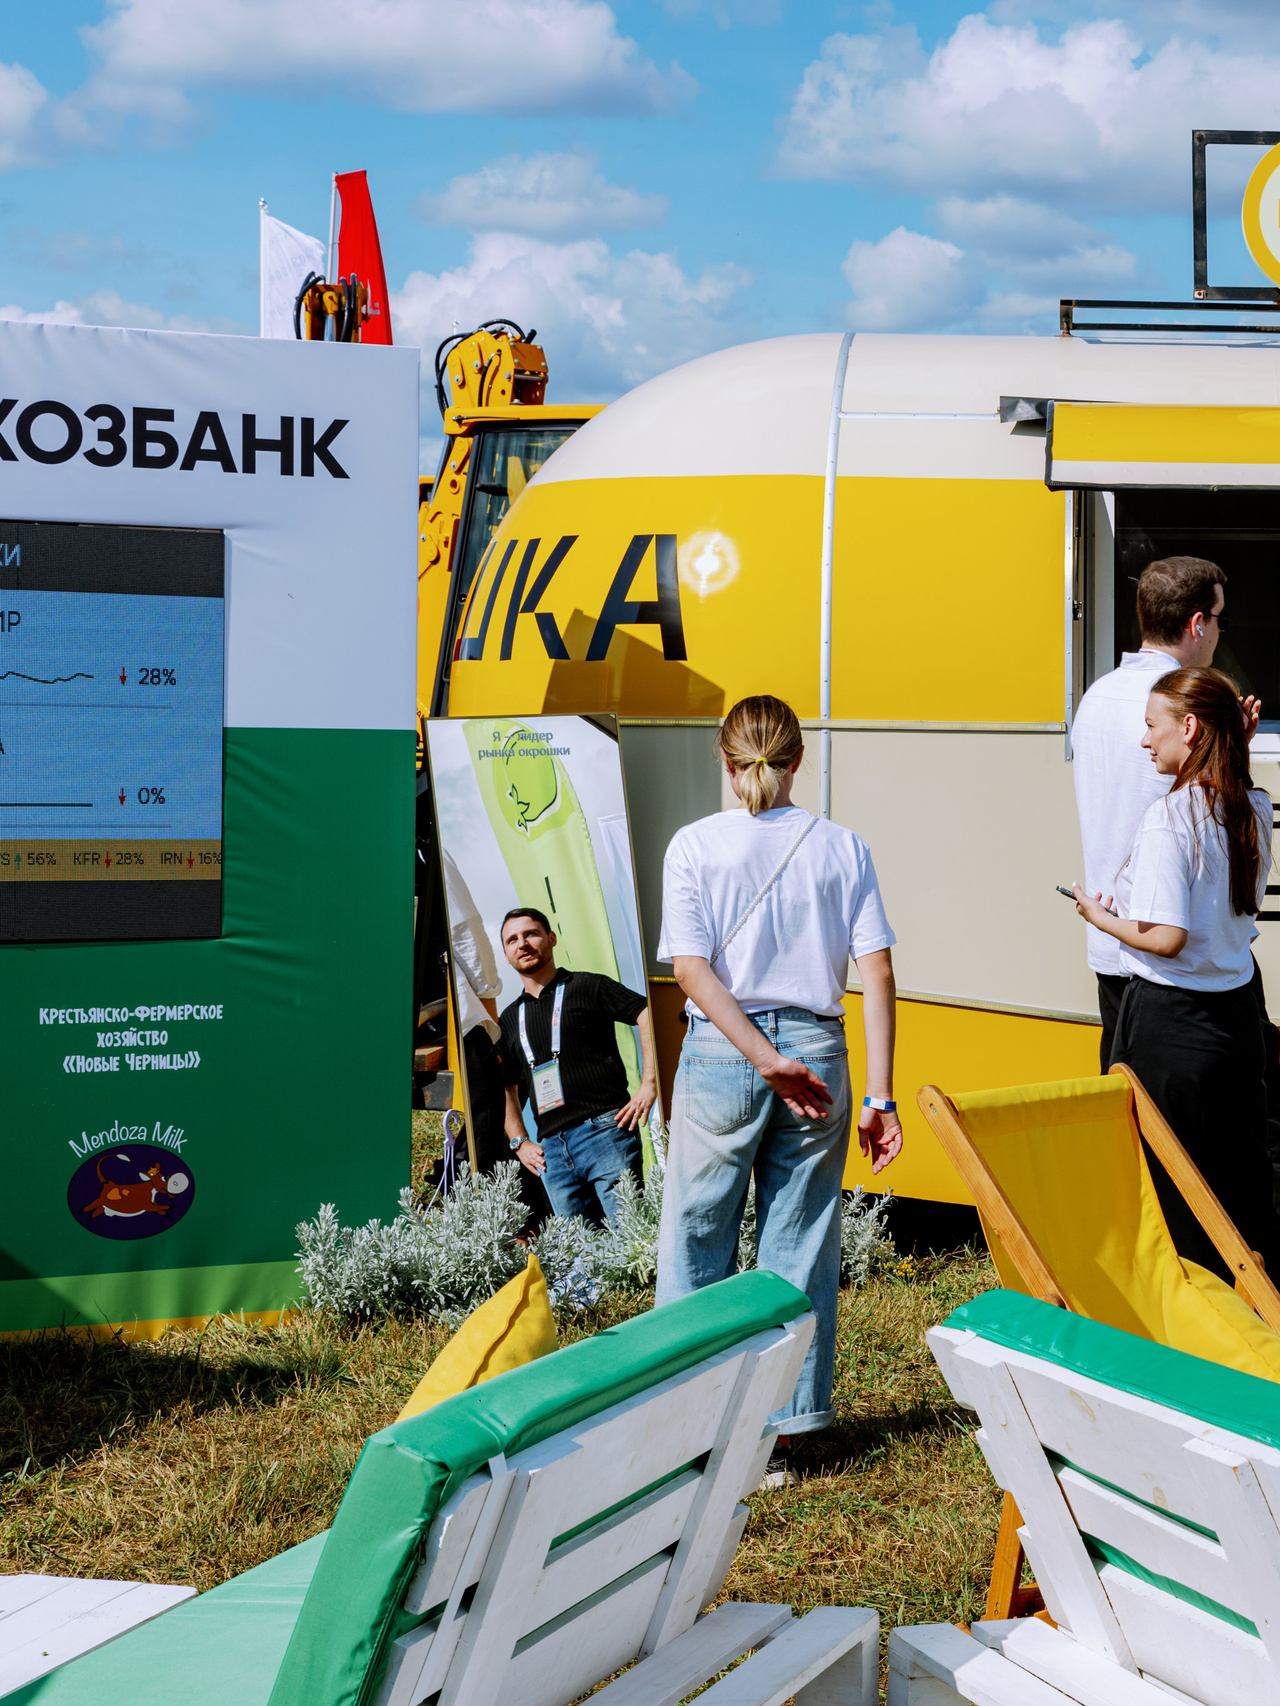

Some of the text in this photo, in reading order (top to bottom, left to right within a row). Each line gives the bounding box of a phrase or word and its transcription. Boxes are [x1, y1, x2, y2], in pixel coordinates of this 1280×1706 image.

[138, 667, 177, 686] 28%
[492, 731, 501, 742] Я
[517, 731, 554, 743] лидер
[478, 747, 571, 761] рынка окрошки
[137, 787, 166, 805] 0%
[27, 852, 57, 866] 56%
[73, 852, 101, 866] KFR
[115, 852, 144, 866] 28%
[160, 852, 183, 865] IRN
[96, 1027, 169, 1048] ХОЗЯЙСТВО
[68, 1120, 188, 1158] Mendoza Milk
